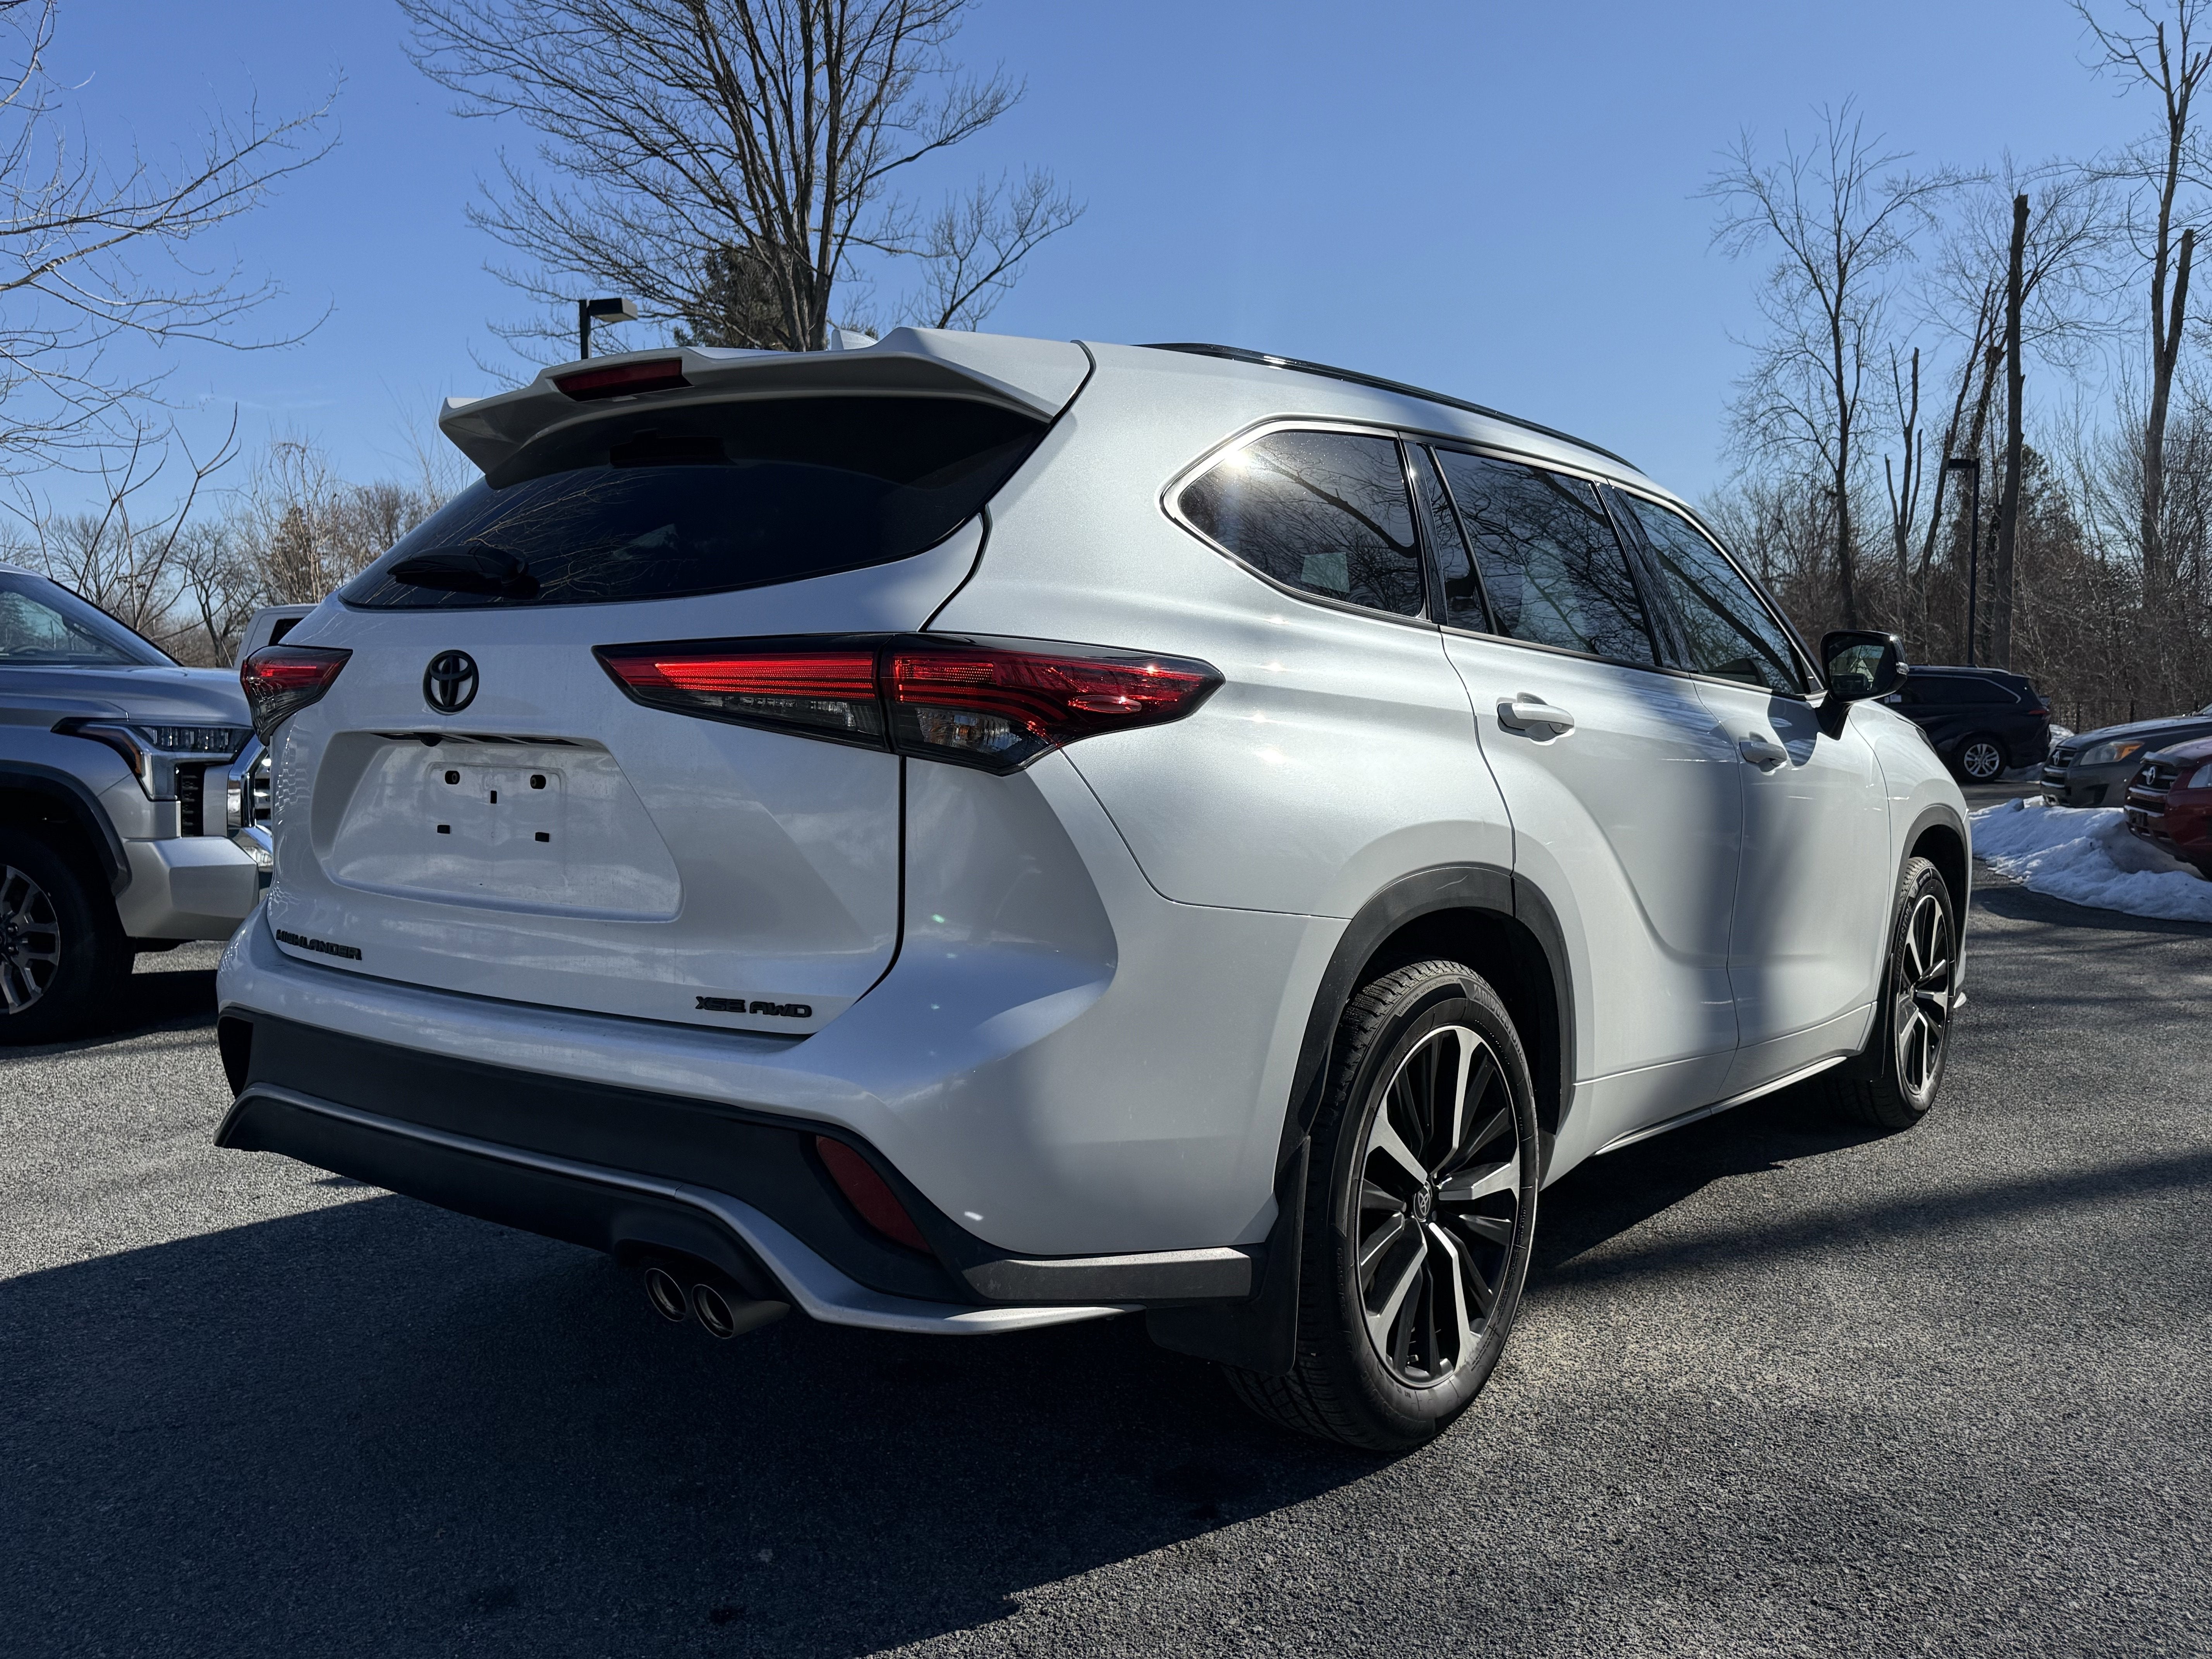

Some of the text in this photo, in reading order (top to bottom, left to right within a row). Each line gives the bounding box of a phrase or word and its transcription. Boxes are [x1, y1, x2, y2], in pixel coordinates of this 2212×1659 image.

[276, 929, 362, 960] HIGHLANDER
[695, 996, 812, 1018] XSE AWD
